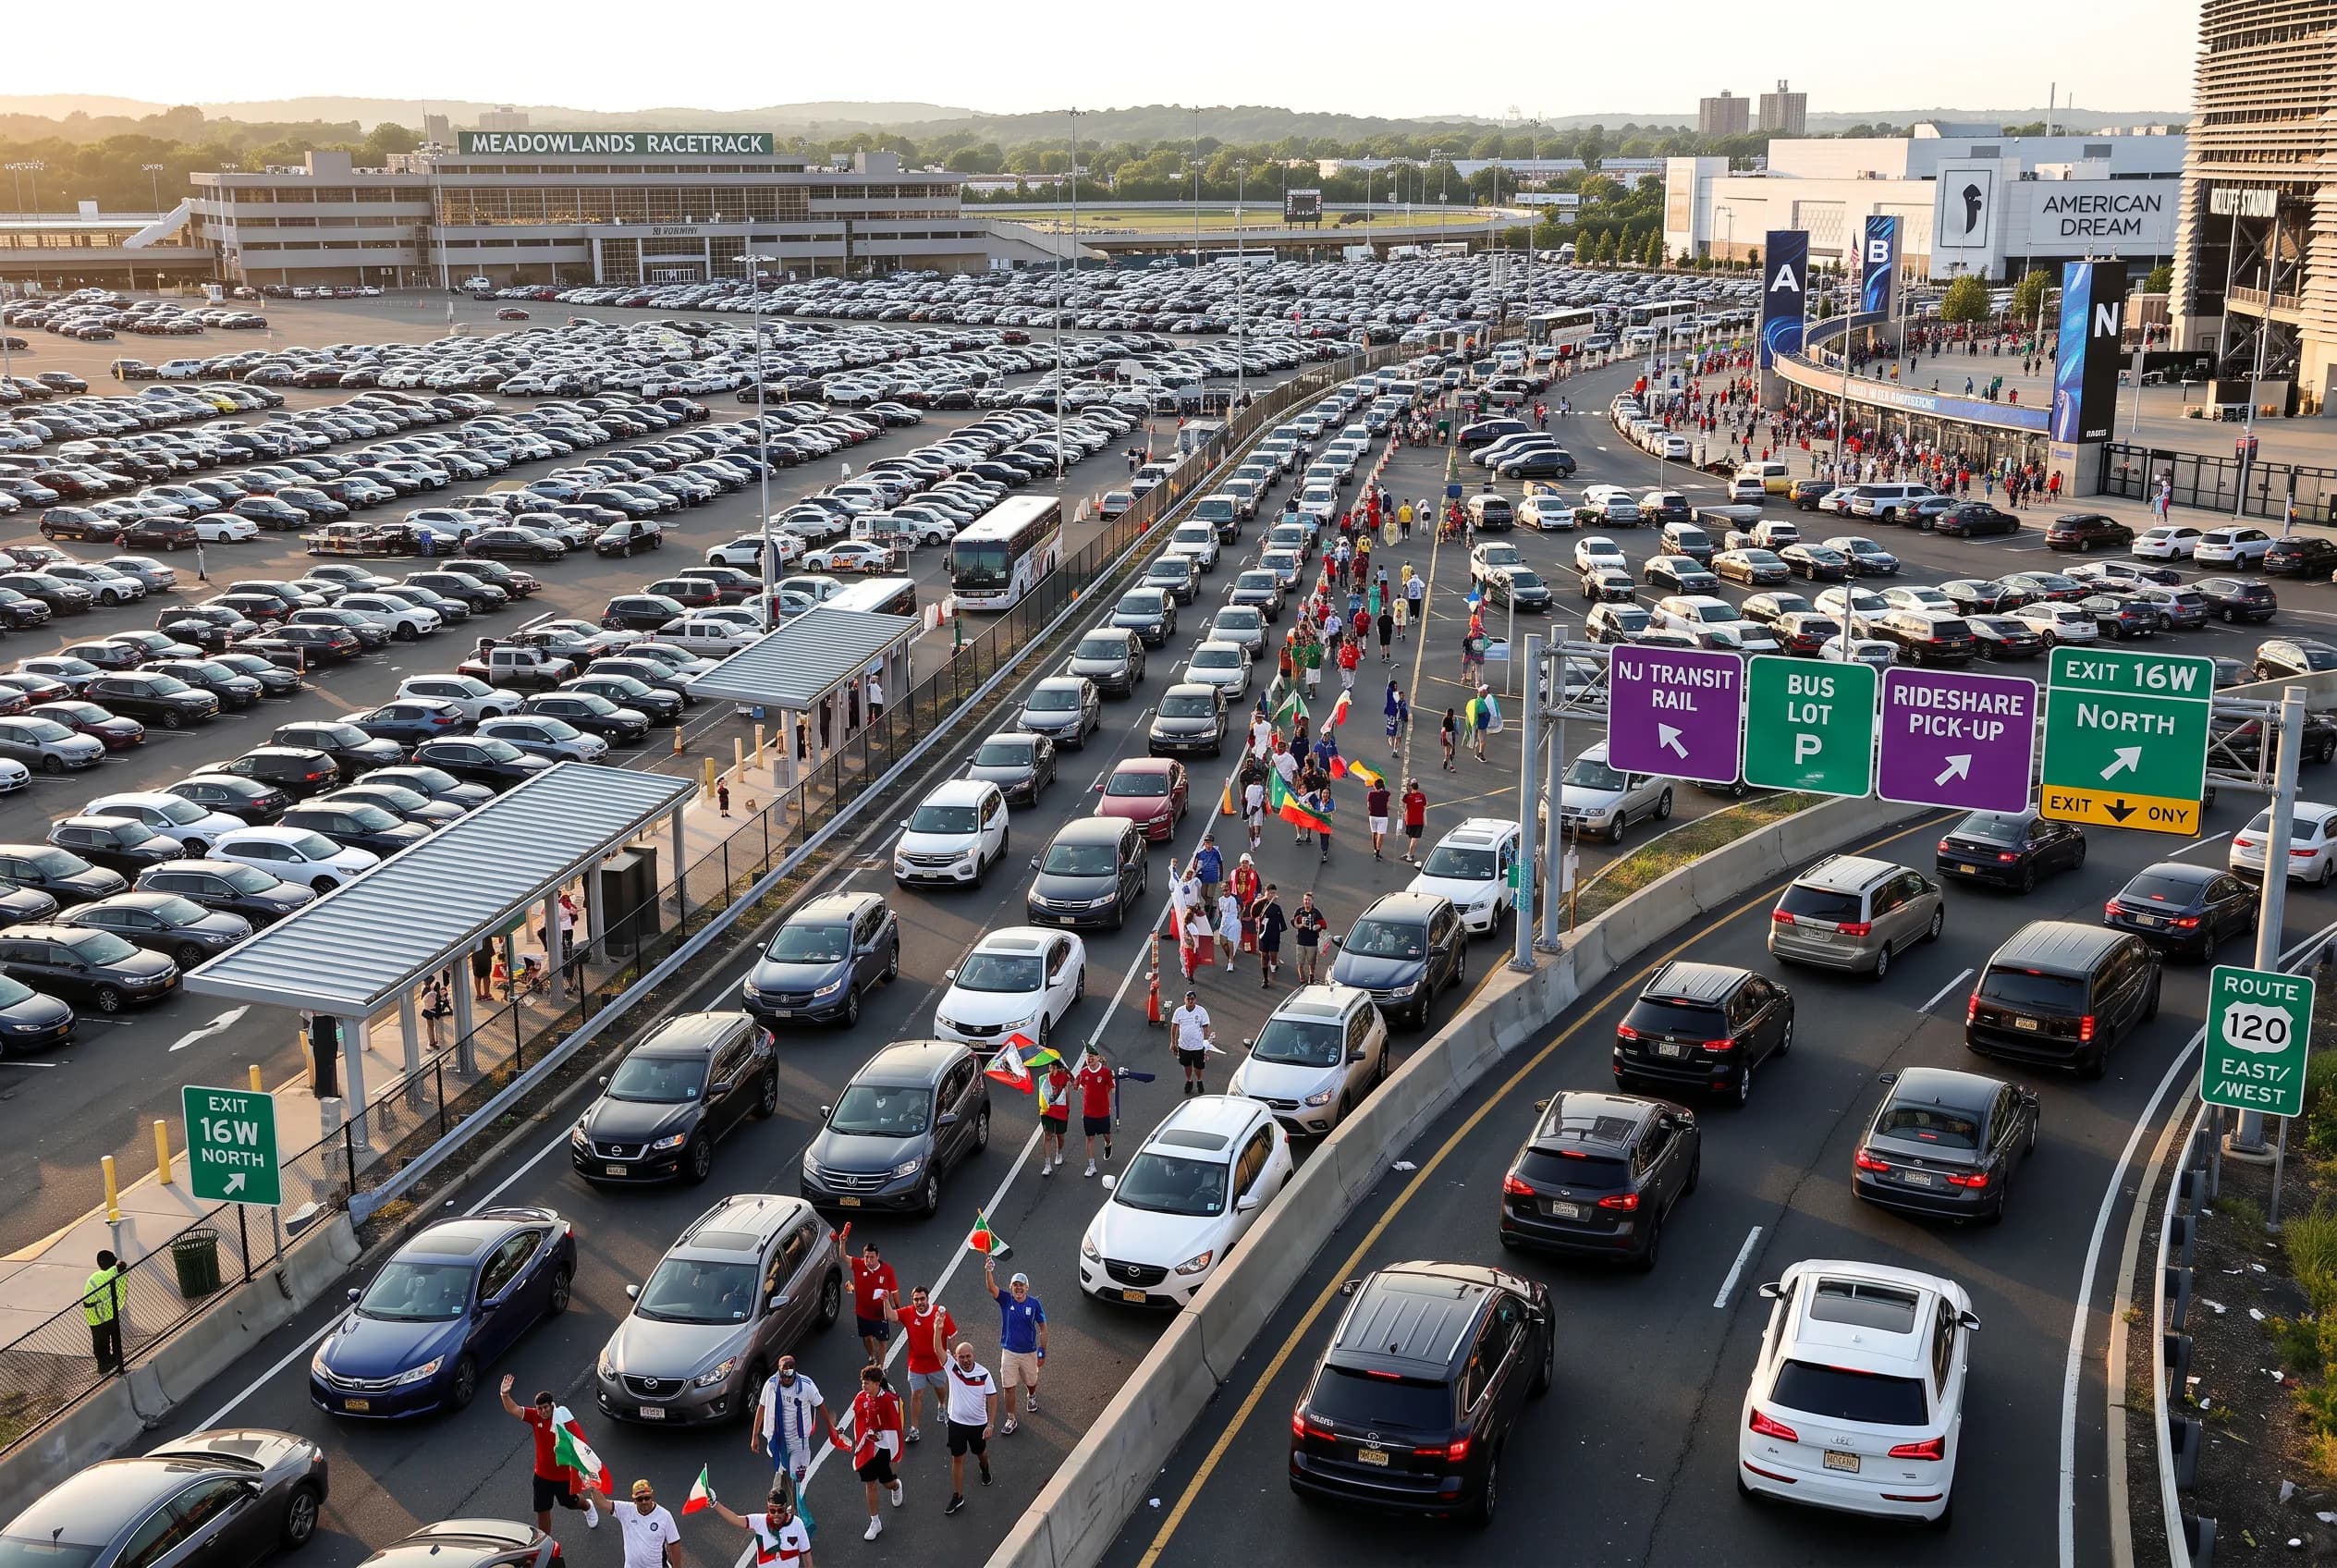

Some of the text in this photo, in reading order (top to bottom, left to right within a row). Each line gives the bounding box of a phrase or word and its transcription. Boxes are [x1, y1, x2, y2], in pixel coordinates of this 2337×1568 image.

[471, 133, 764, 153] MEADOWLANDS RACETRACK
[2042, 194, 2161, 214] AMERICAN
[2061, 217, 2141, 236] DREAM
[1867, 239, 1889, 263] B
[1769, 263, 1800, 292] A
[2094, 301, 2120, 338] N
[1618, 660, 1734, 690] NJ TRANSIT
[1787, 674, 1835, 698] BUS
[2065, 660, 2198, 692] EXIT 16W
[1651, 689, 1698, 713] RAIL
[1893, 684, 2025, 717] RIDESHARE
[1787, 701, 1833, 726] LOT
[1909, 713, 2005, 741] PICK-UP
[1794, 732, 1822, 766] P
[2050, 795, 2190, 825] EXIT ONY
[2224, 975, 2299, 1001] ROUTE
[2230, 1012, 2287, 1045] 120
[2221, 1058, 2291, 1083] EAST/
[208, 1096, 248, 1114] EXIT
[2212, 1080, 2286, 1105] /WEST
[200, 1116, 258, 1146] 16W
[202, 1147, 264, 1168] NORTH
